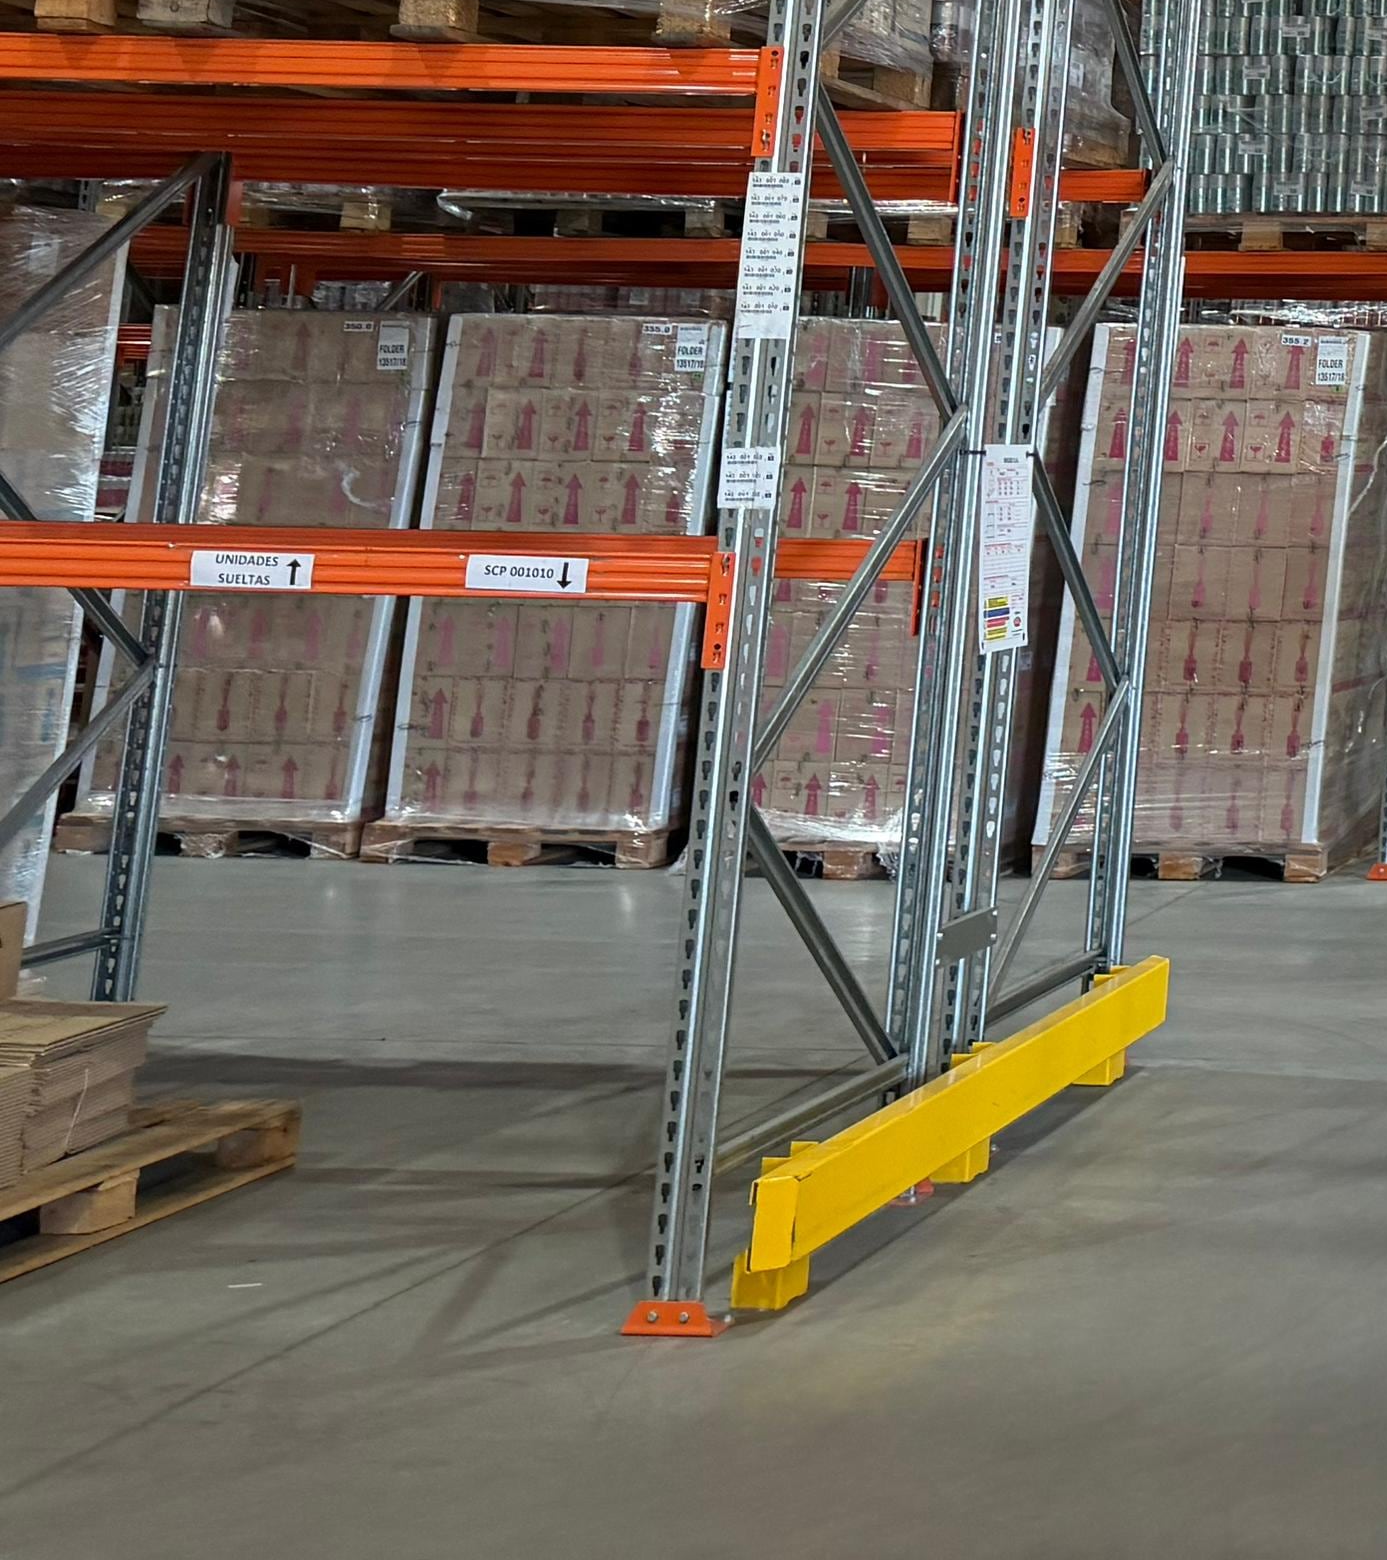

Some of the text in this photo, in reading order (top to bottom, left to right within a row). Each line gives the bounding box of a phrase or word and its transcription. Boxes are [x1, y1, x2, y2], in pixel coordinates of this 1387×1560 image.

[378, 344, 405, 354] FOLDER
[677, 345, 704, 356] FOLDER
[1318, 359, 1343, 369] FOLDER
[215, 554, 279, 568] UNIDADES
[483, 564, 554, 580] SCP 001010
[218, 572, 271, 586] SUELTAS
